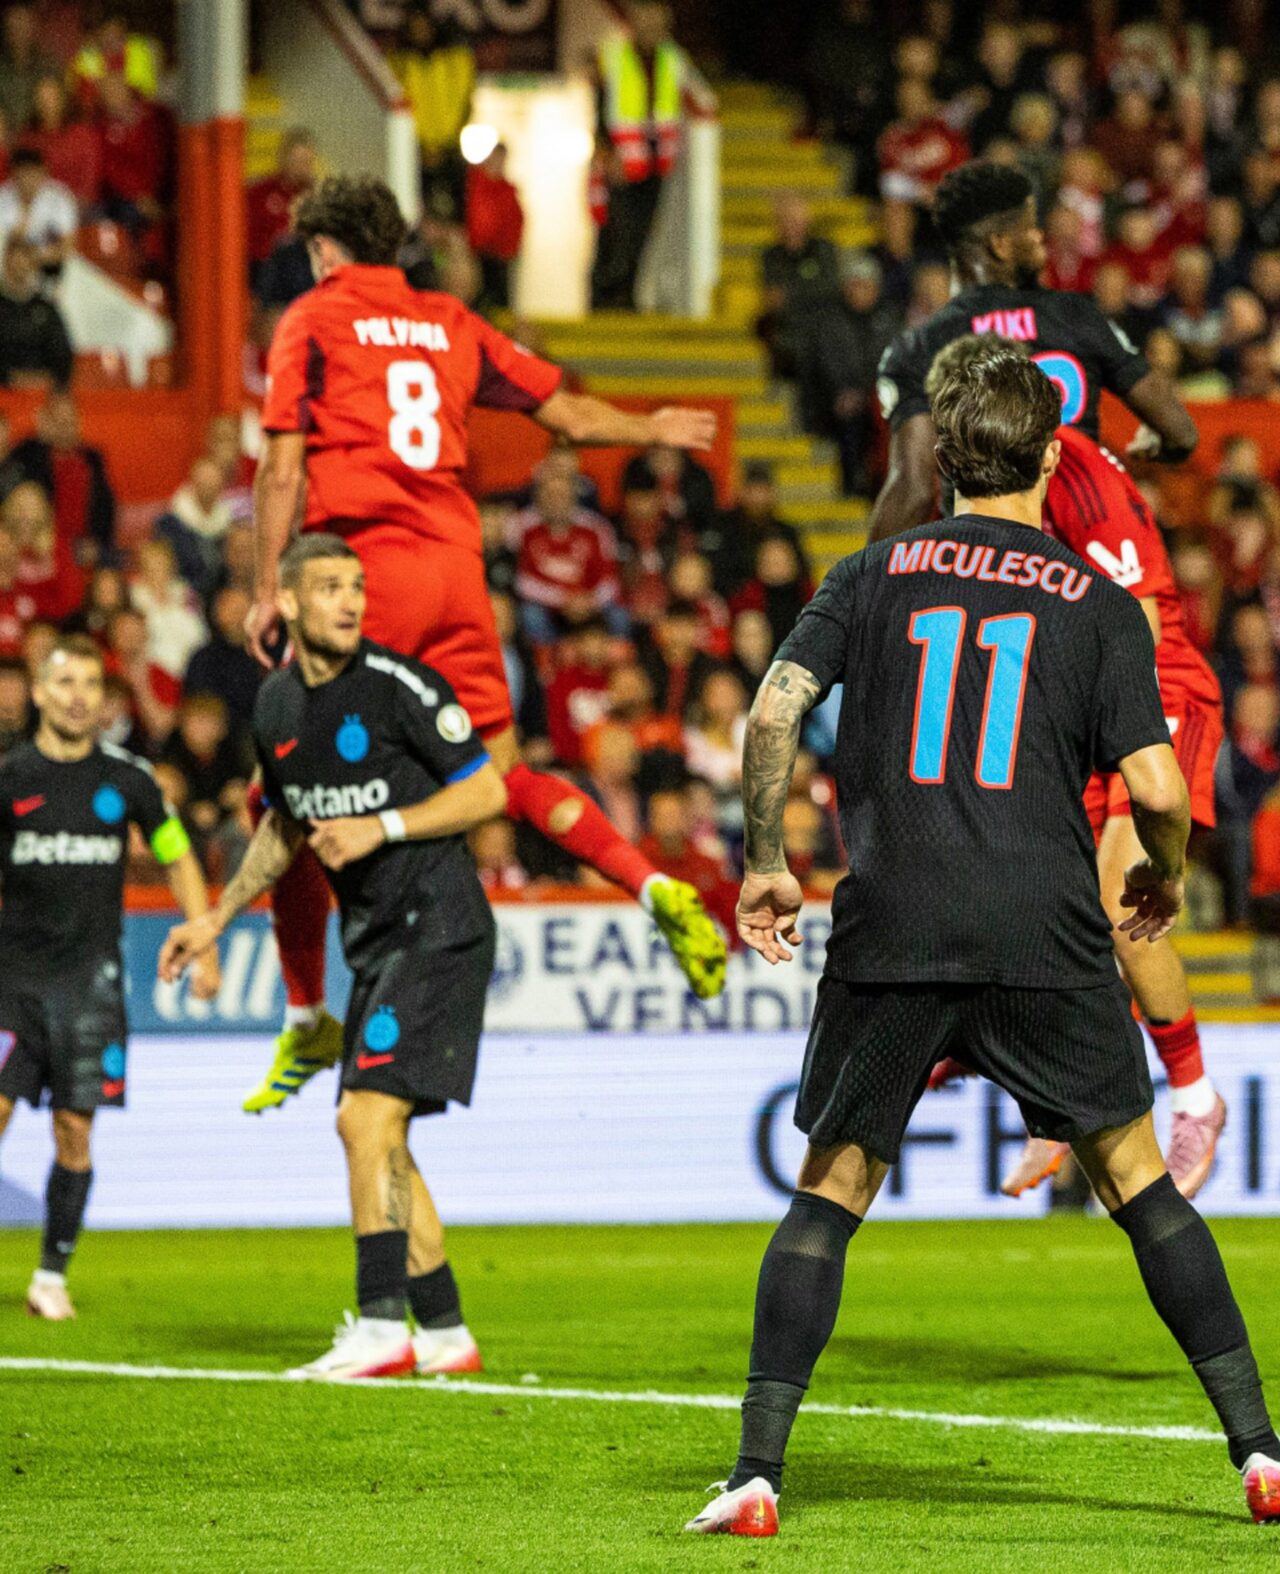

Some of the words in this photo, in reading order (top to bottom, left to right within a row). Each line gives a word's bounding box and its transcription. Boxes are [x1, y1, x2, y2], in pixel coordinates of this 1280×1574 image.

[386, 360, 441, 471] 8
[888, 539, 1092, 601] MICULESCU
[907, 605, 1037, 790] 11
[11, 830, 123, 865] Betano
